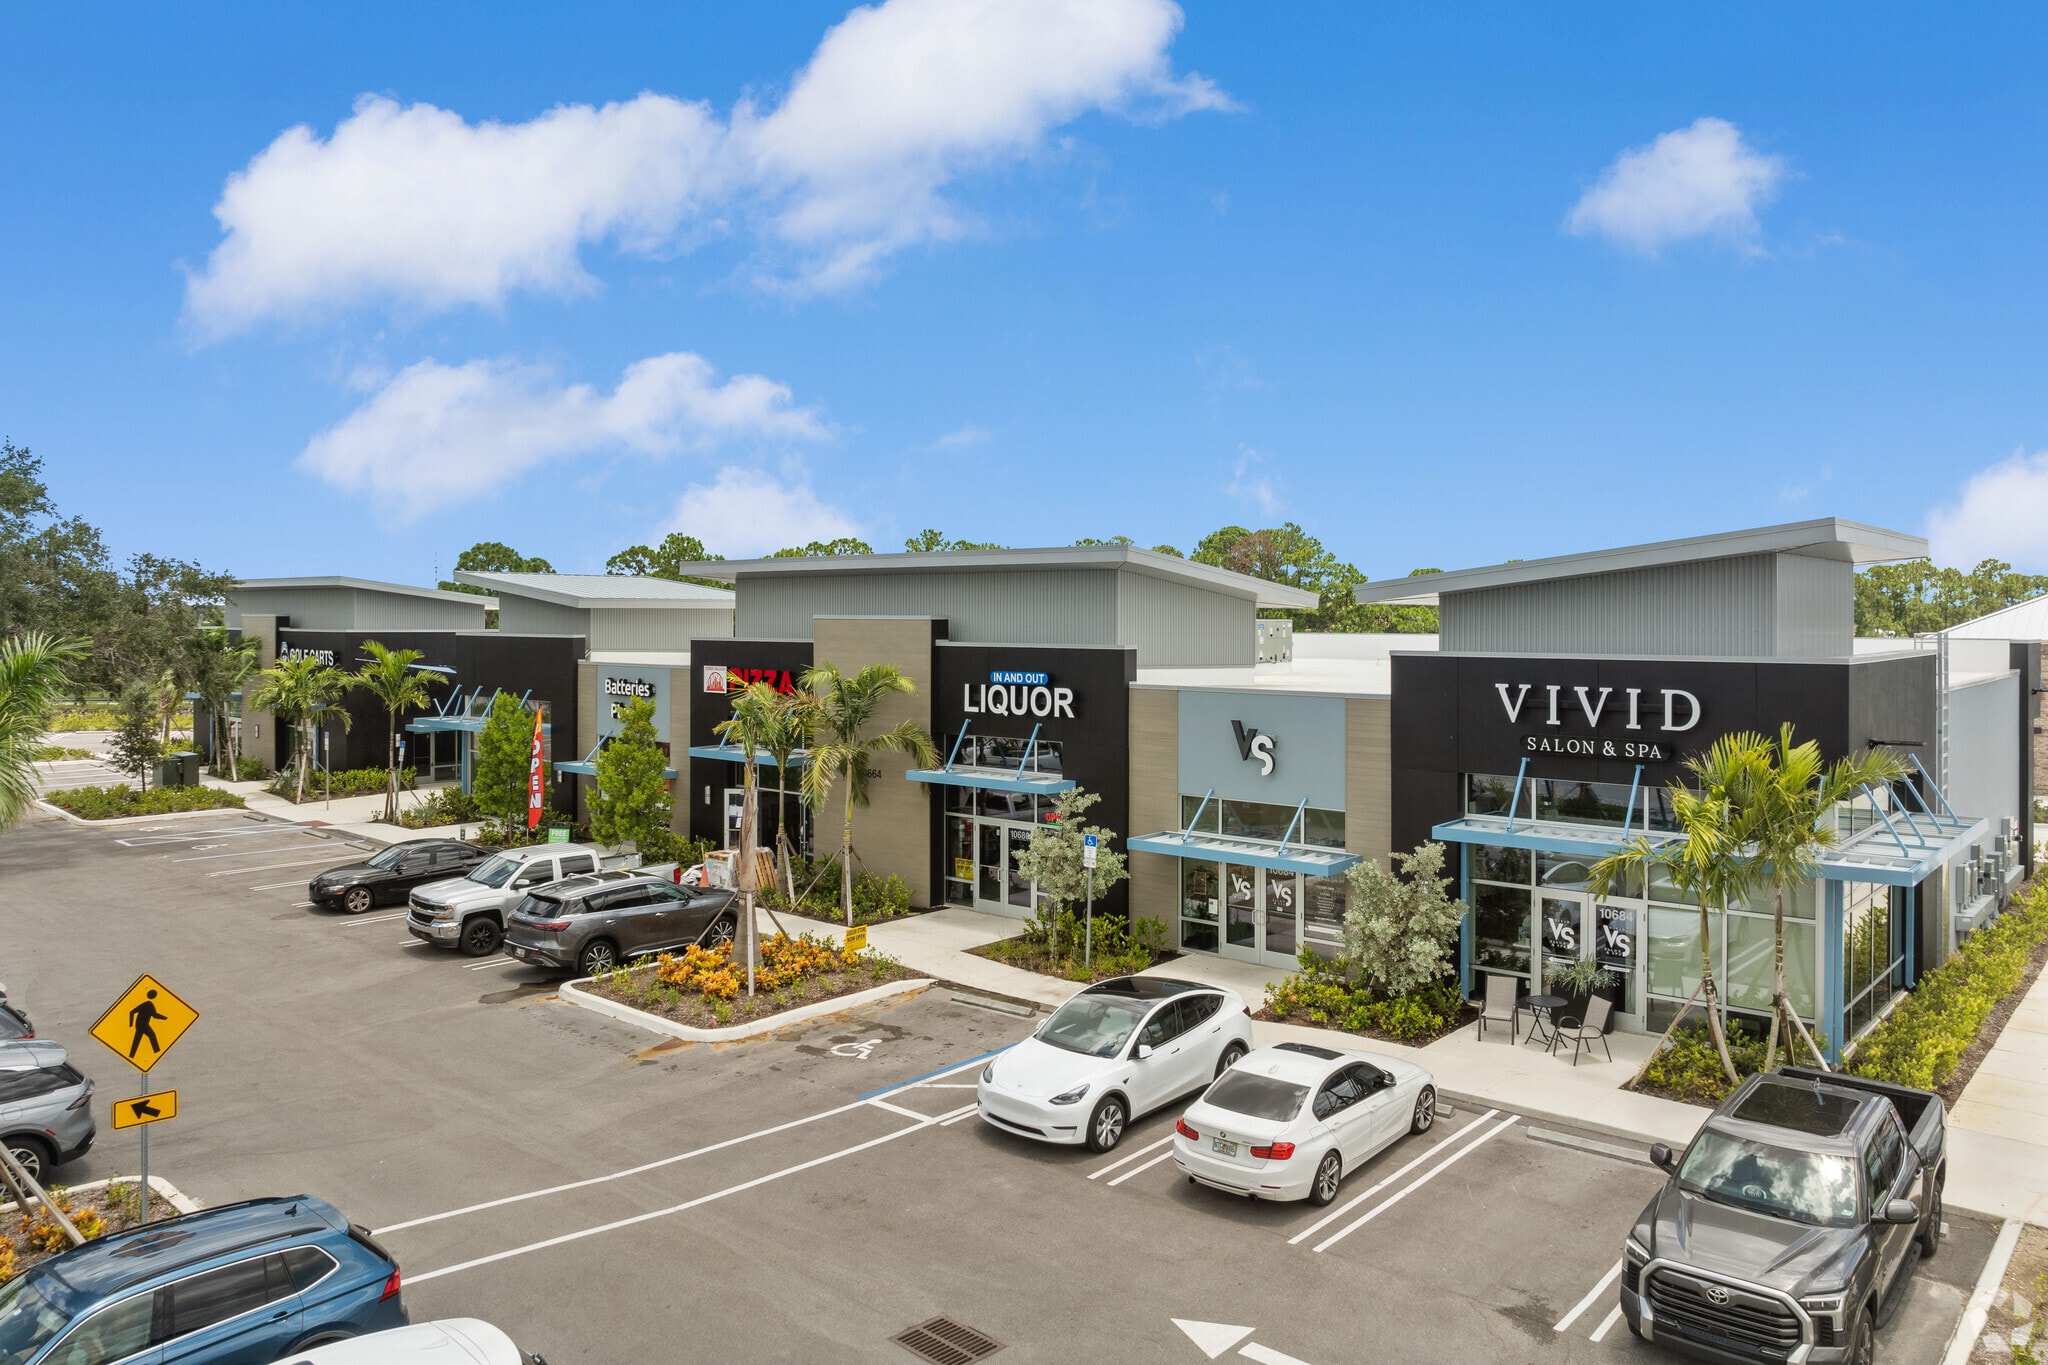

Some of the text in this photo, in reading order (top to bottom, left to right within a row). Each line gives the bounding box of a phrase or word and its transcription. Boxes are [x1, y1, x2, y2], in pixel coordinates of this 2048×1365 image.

[605, 678, 651, 697] Batteries
[729, 667, 794, 695] PIZZA
[993, 672, 1045, 684] IN AND OUT
[964, 683, 1075, 718] LIQUOR
[1495, 683, 1701, 732] VIVID
[1231, 719, 1275, 776] VS
[1527, 736, 1662, 759] SALON & SPA
[1231, 873, 1251, 900] VS
[1271, 879, 1292, 907] VS
[1599, 908, 1633, 922] 10684
[1548, 917, 1575, 949] VS
[1603, 925, 1630, 957] VS
